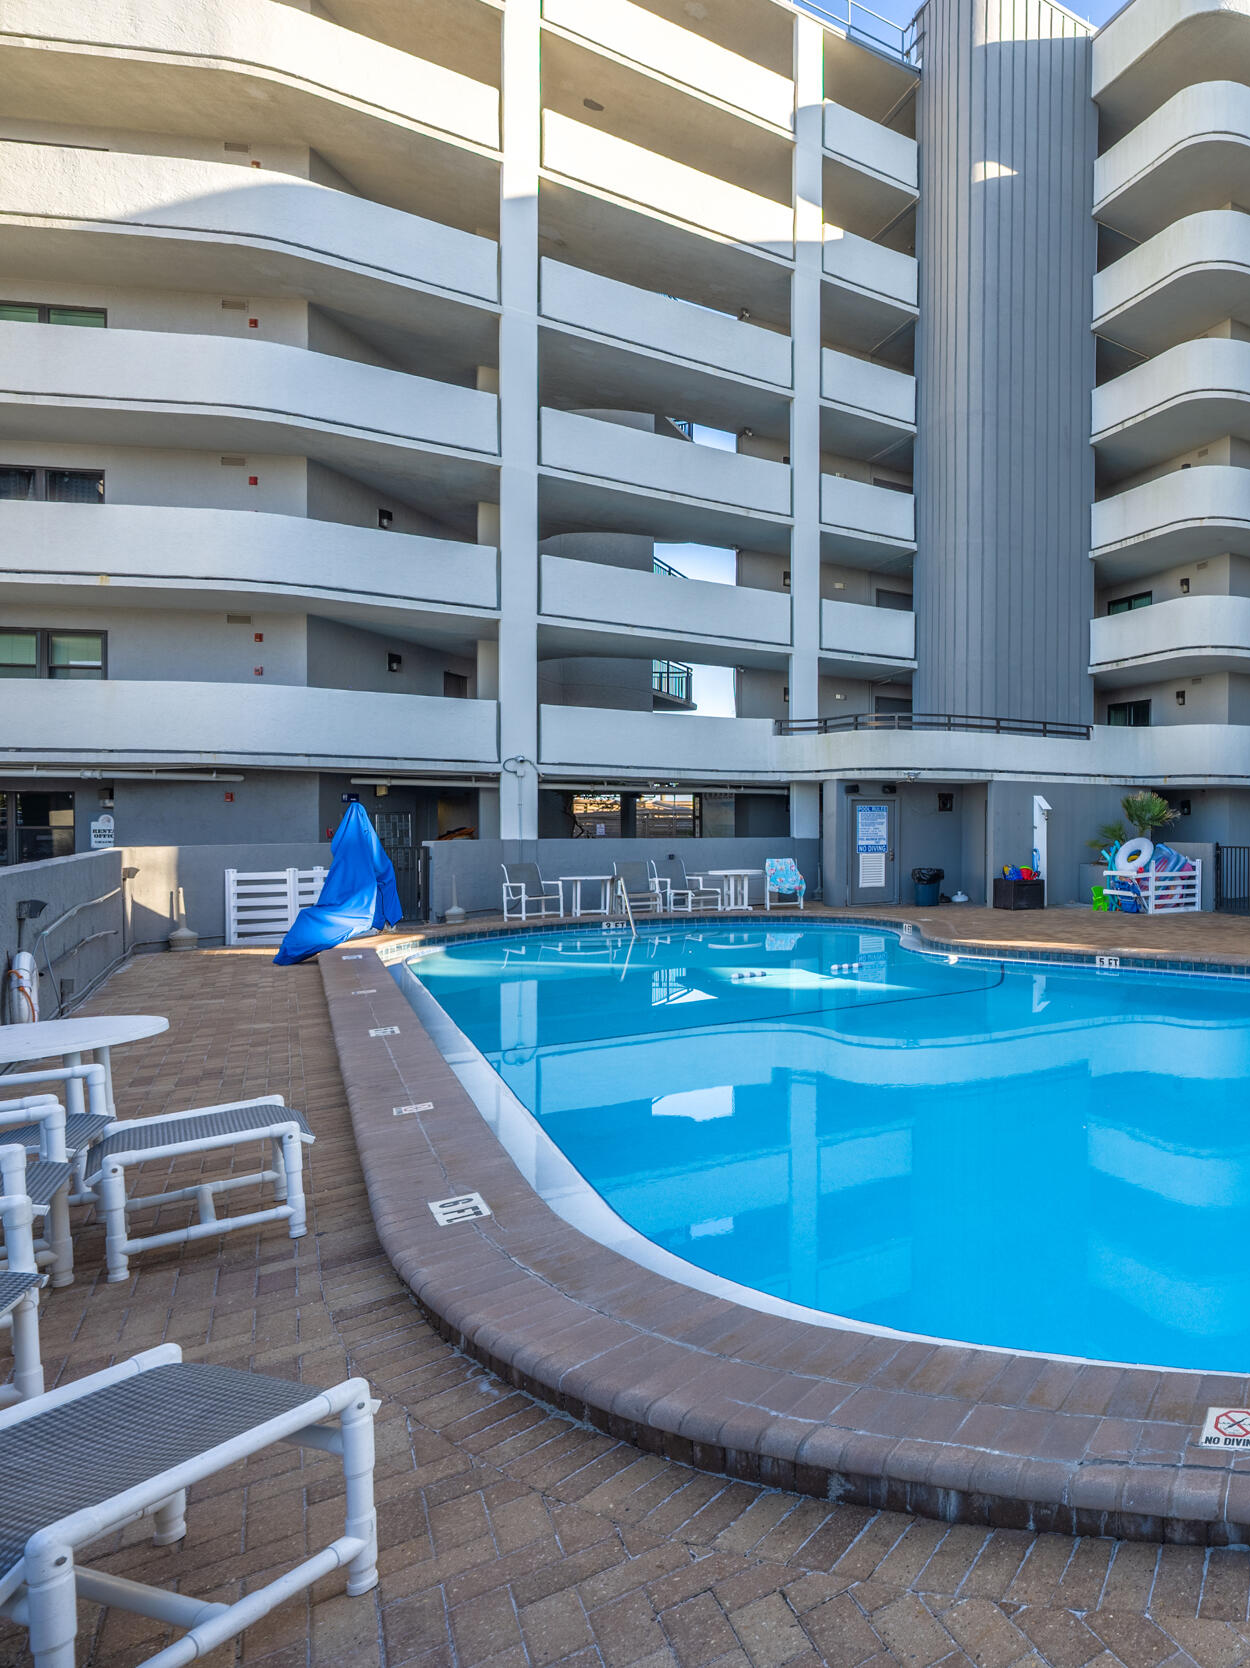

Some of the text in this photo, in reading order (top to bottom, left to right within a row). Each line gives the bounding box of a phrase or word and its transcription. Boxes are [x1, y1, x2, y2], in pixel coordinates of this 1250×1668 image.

[1099, 957, 1119, 967] 5 FT
[1204, 1436, 1220, 1445] NO
